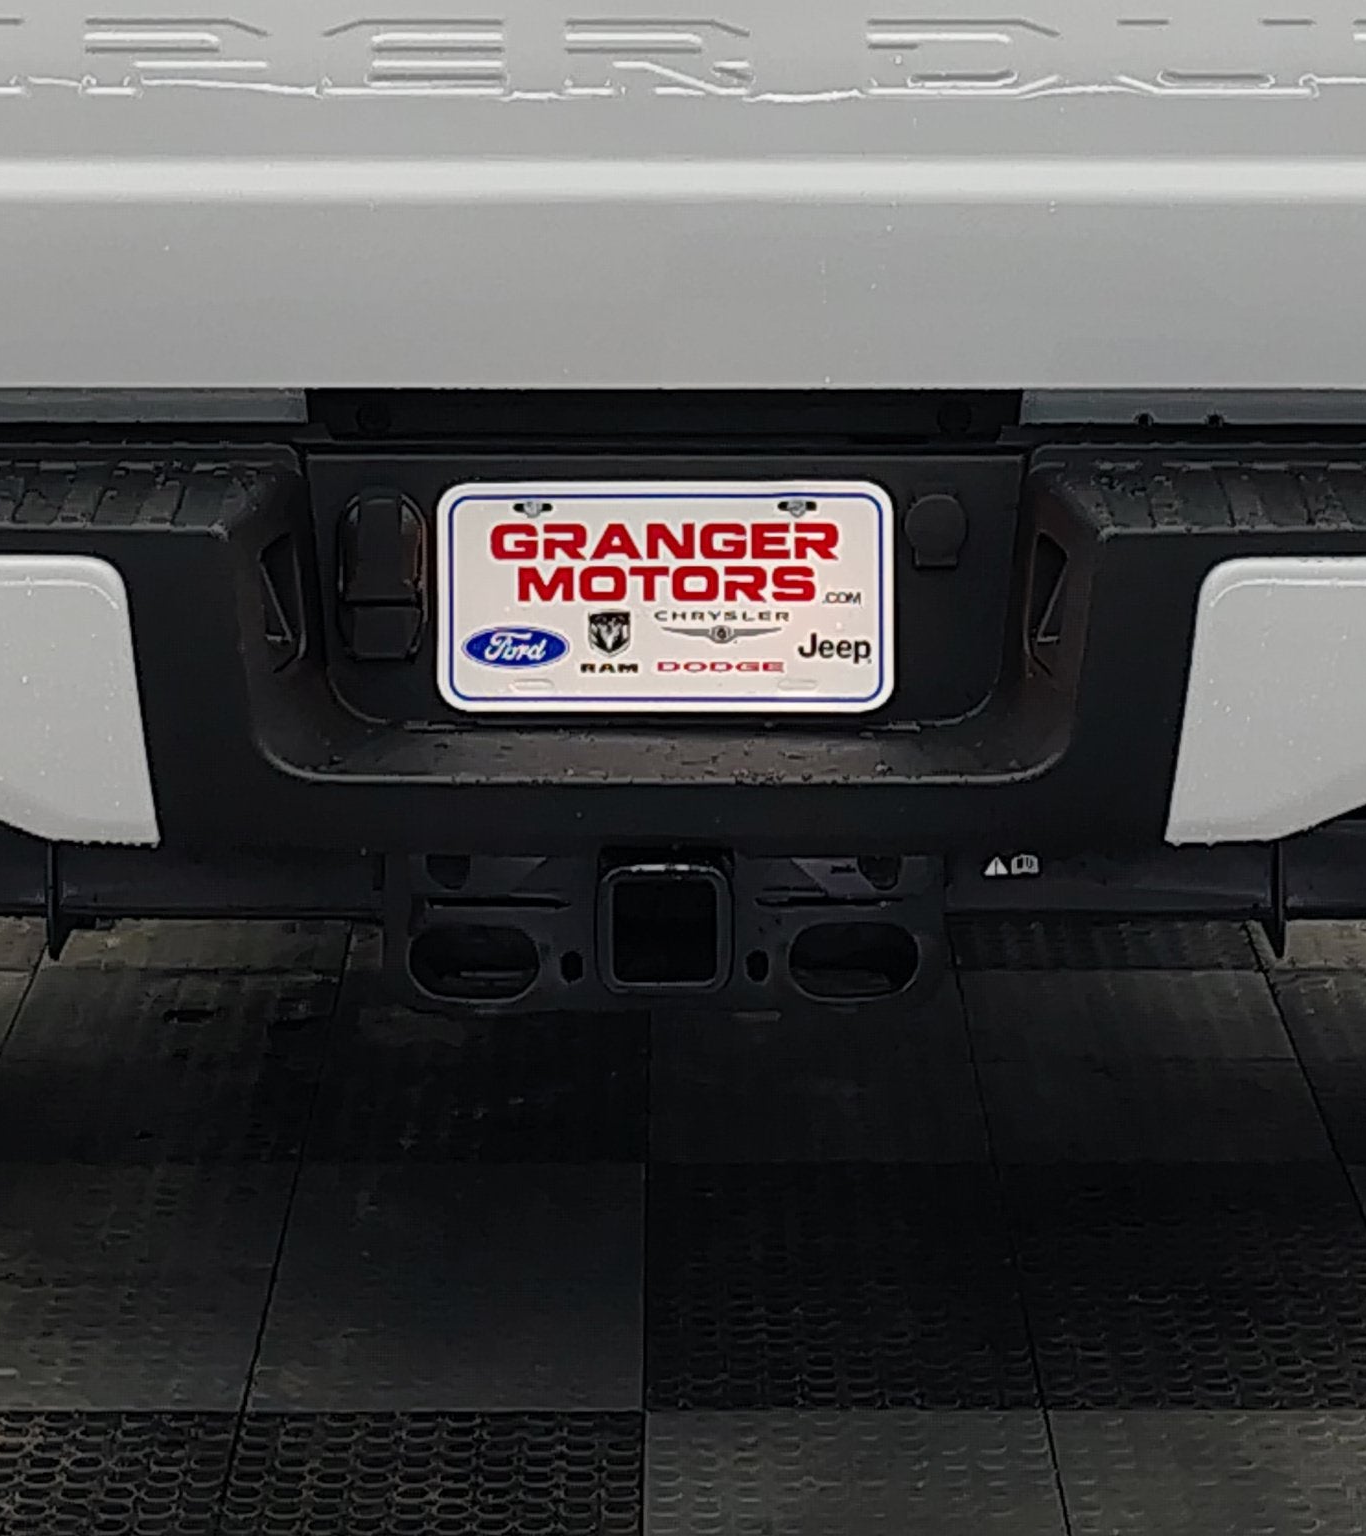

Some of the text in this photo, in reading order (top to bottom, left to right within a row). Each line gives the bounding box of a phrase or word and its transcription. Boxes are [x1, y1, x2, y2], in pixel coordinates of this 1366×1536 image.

[490, 523, 839, 560] GRANGER
[517, 565, 817, 603] MOTORS
[653, 609, 790, 623] CHRYSLER
[483, 631, 547, 662] Ford
[798, 632, 871, 664] Jeep
[579, 662, 639, 674] RAM
[656, 661, 785, 673] DODGE
